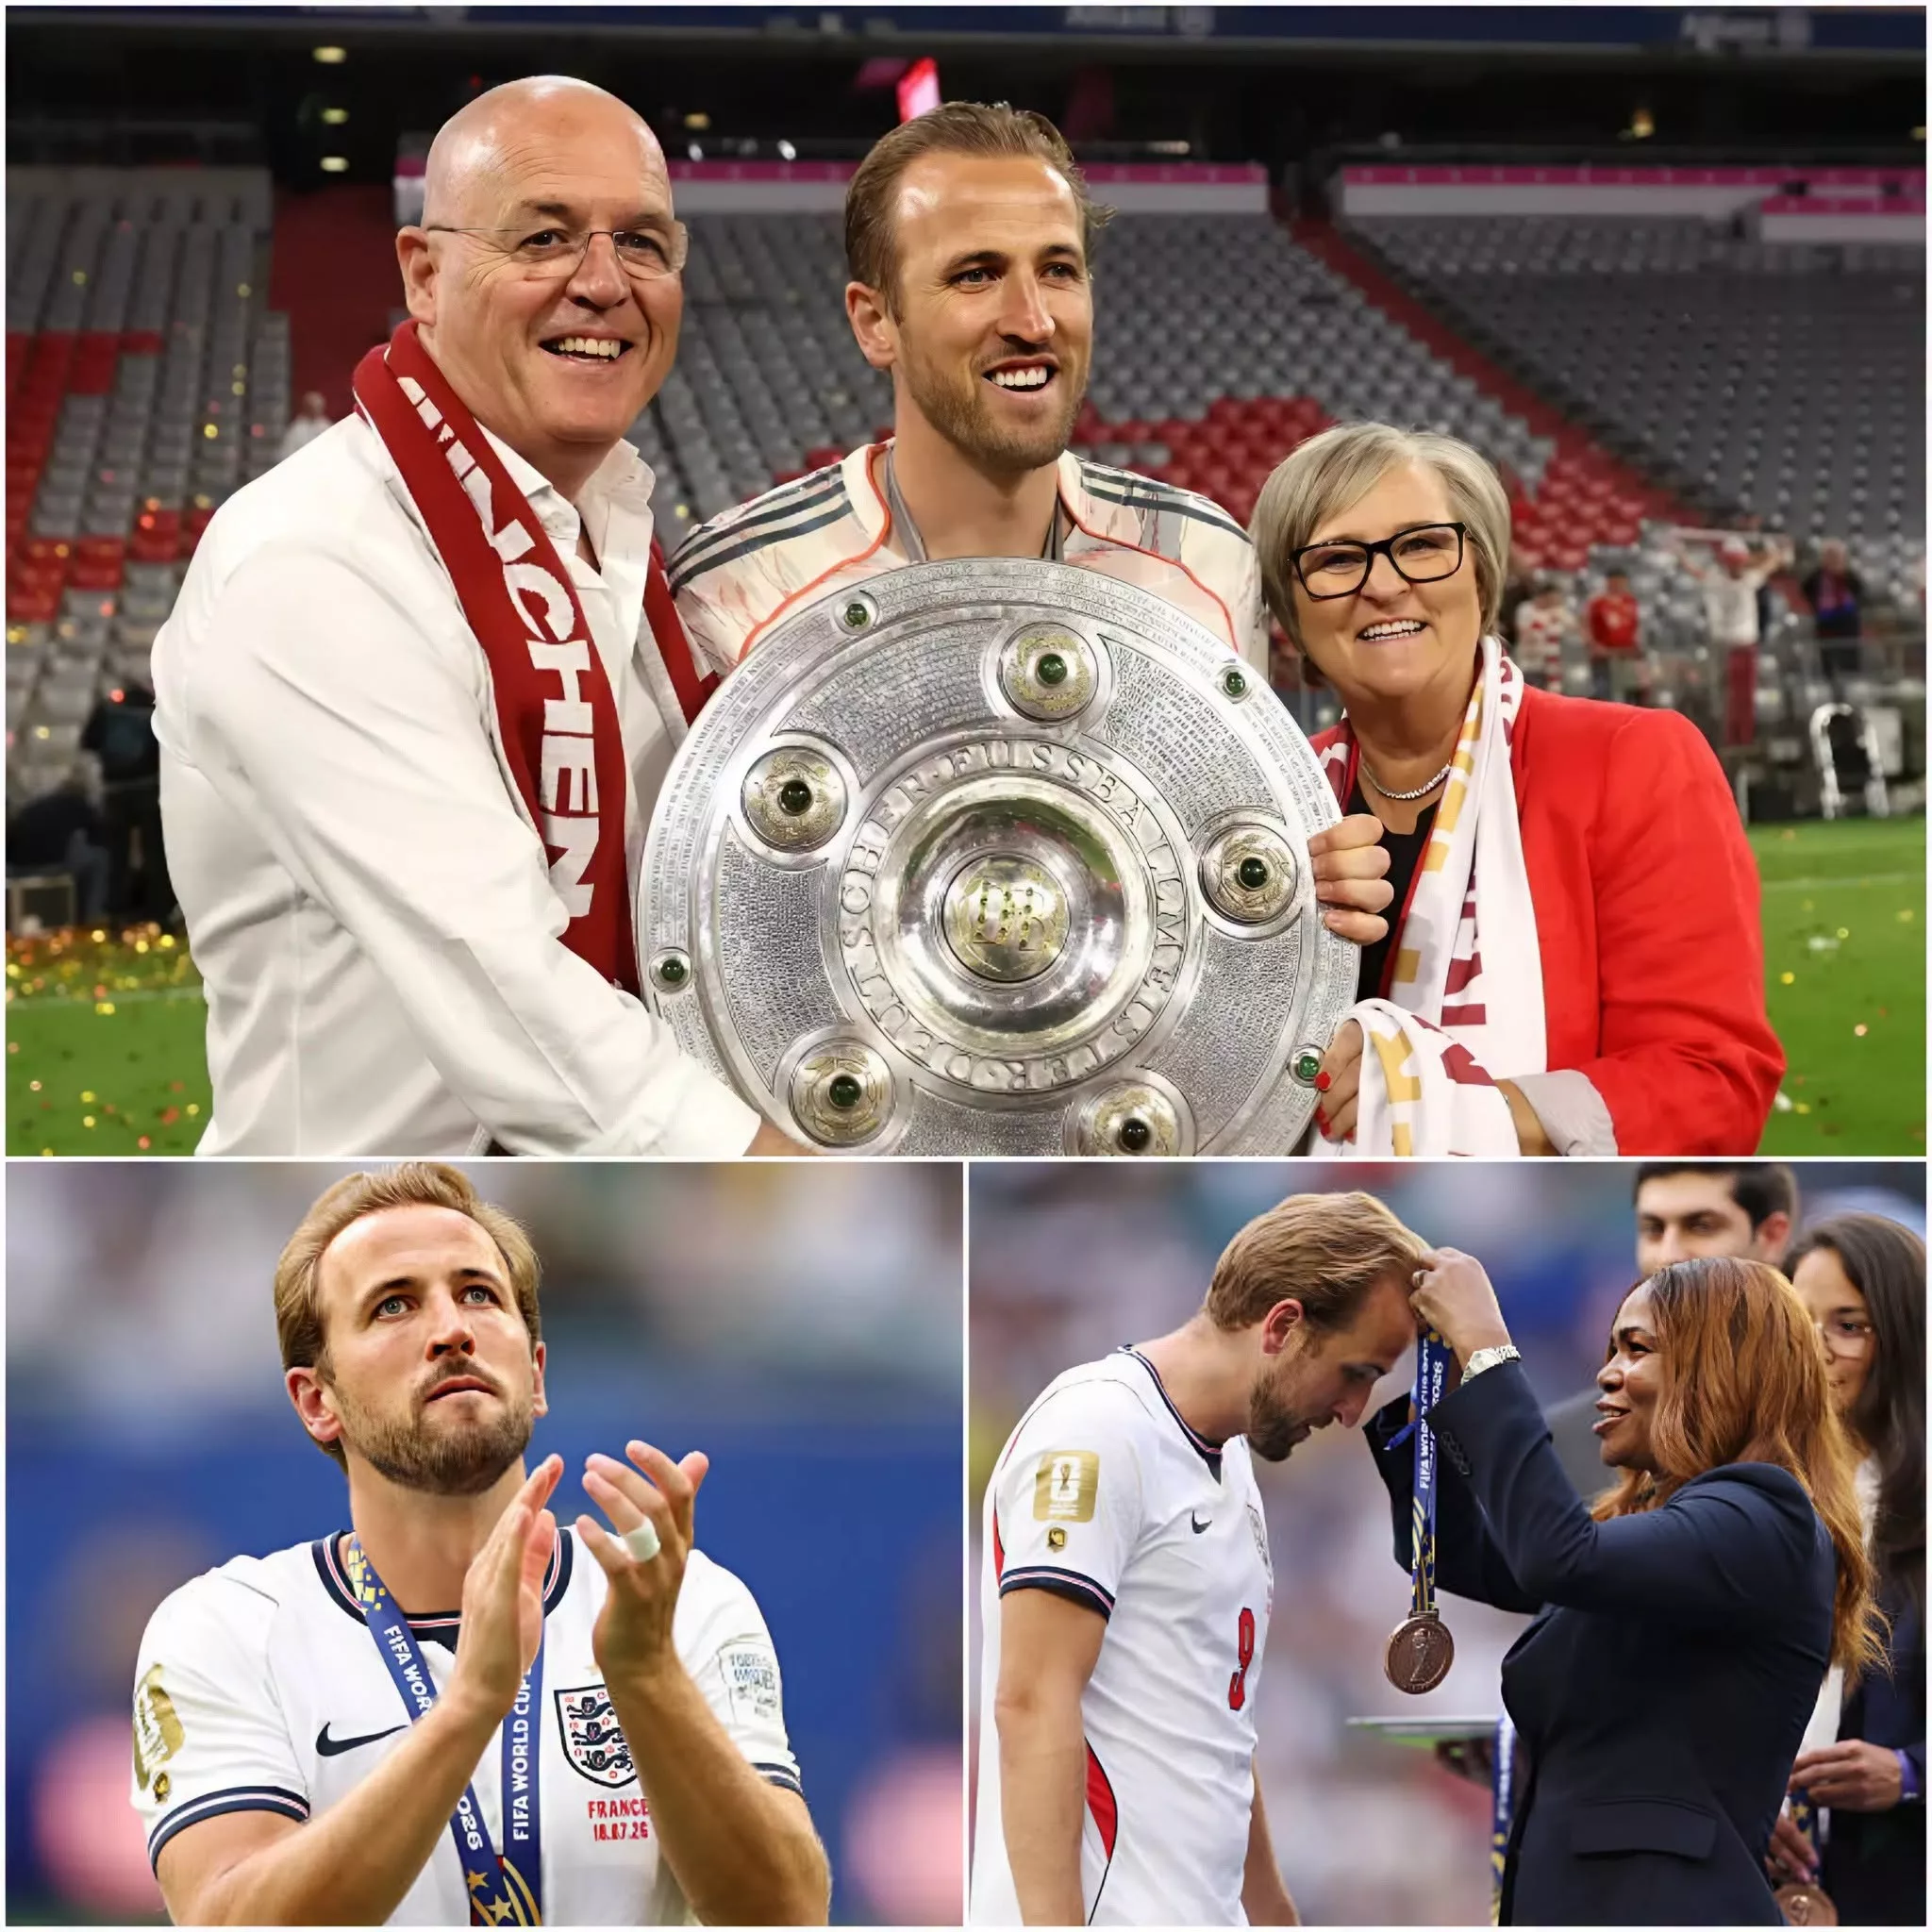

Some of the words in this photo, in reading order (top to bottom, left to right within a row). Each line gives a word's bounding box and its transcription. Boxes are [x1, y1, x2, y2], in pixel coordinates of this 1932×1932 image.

[1419, 1458, 1430, 1490] FIFA
[1228, 1607, 1255, 1711] 9
[383, 1624, 412, 1665] FIFA
[404, 1662, 434, 1719] WOR
[457, 1795, 484, 1851] 026
[512, 1718, 530, 1792] WORLD
[512, 1795, 529, 1840] FIFA
[588, 1798, 649, 1819] FRANCE
